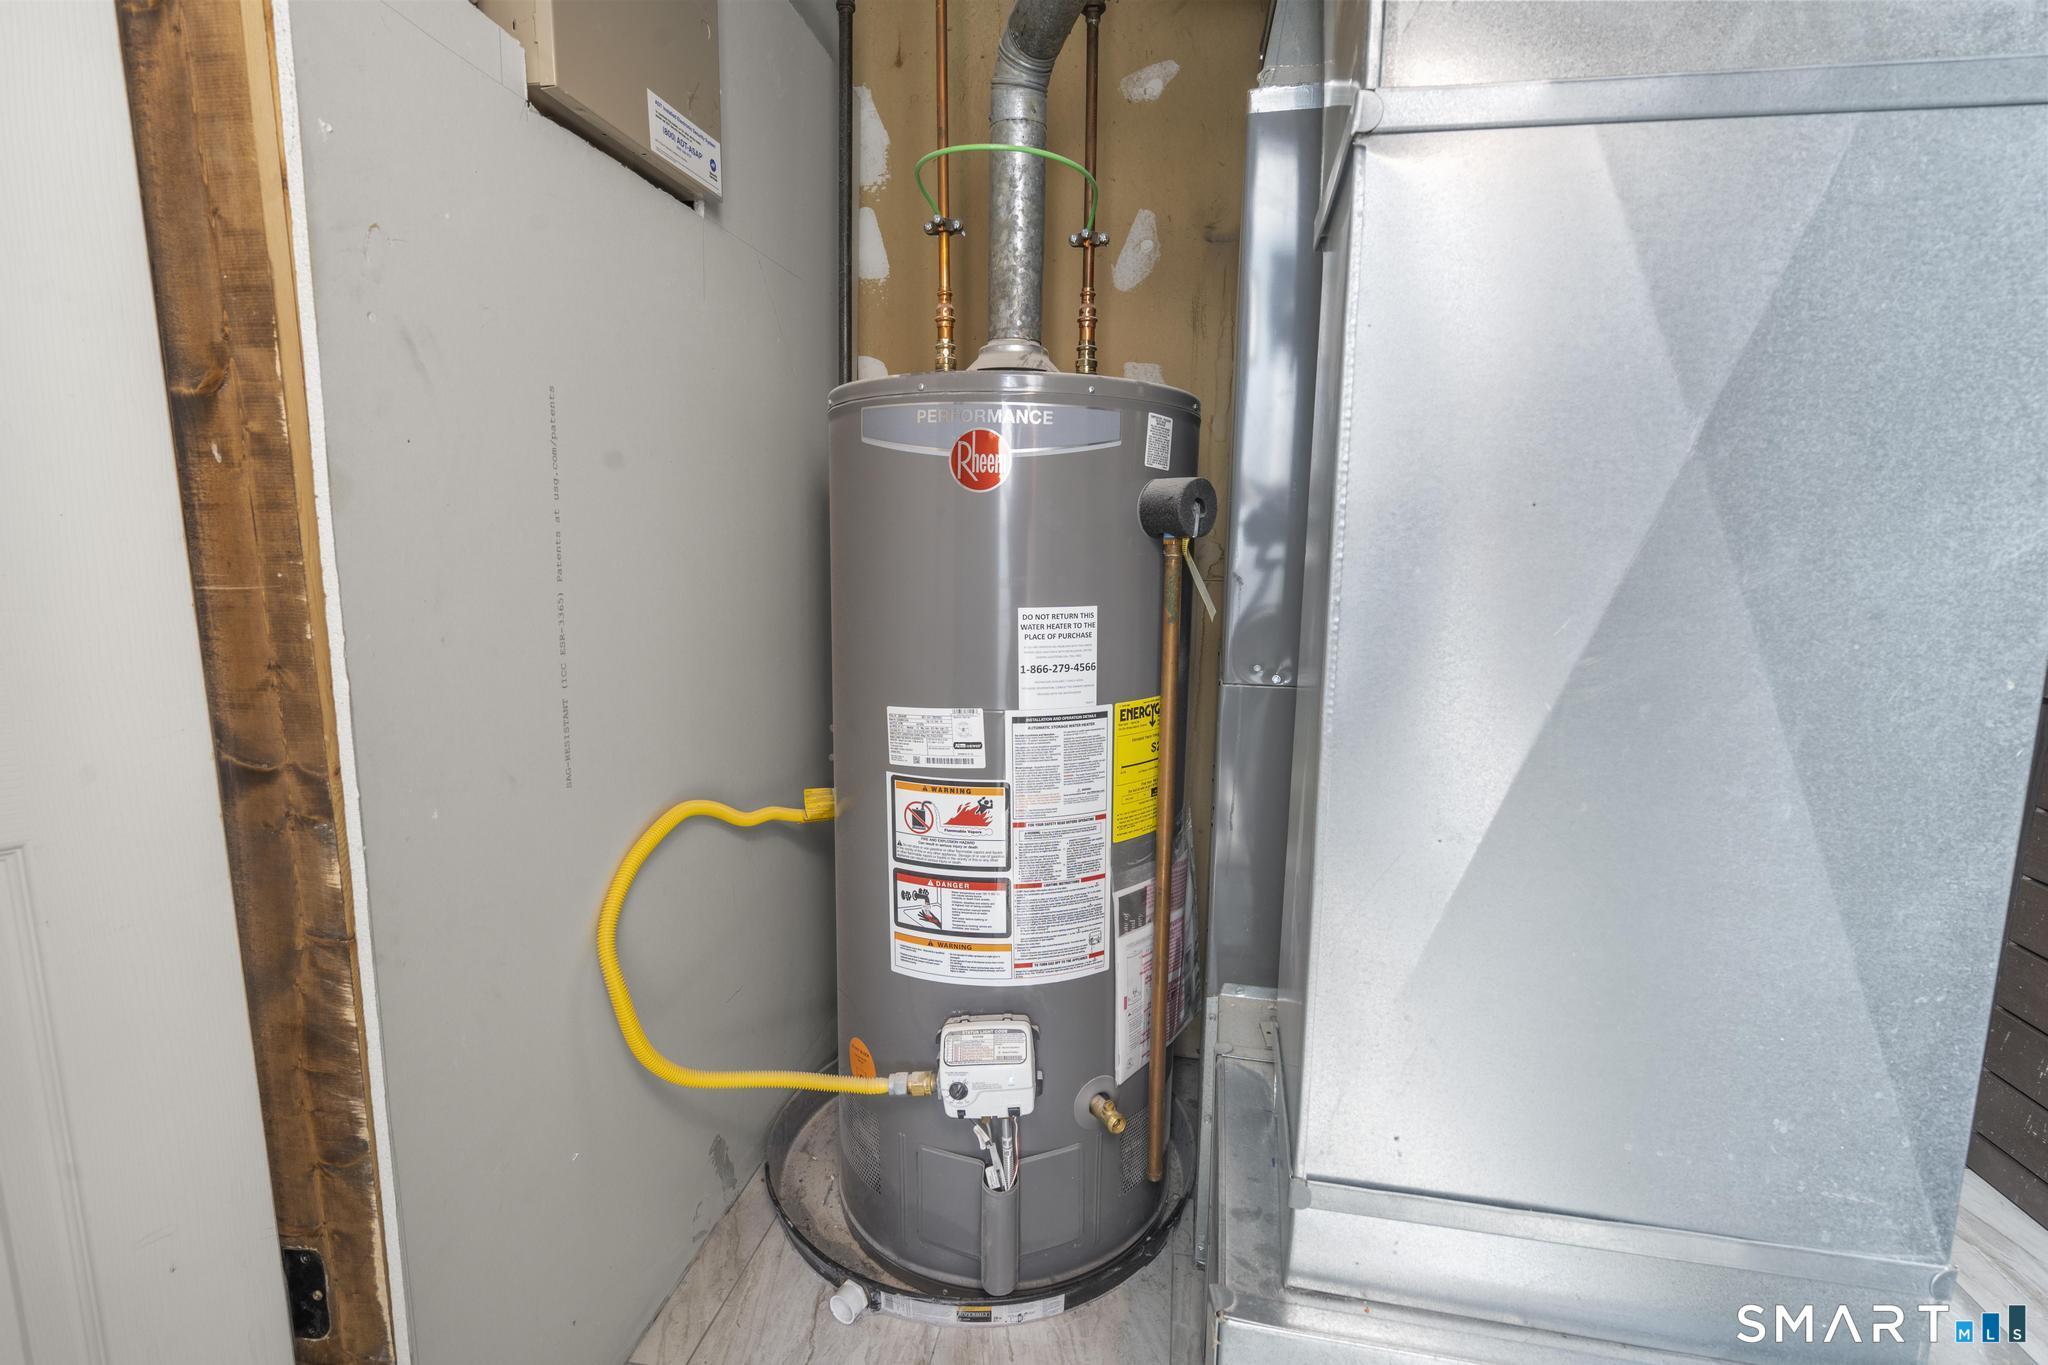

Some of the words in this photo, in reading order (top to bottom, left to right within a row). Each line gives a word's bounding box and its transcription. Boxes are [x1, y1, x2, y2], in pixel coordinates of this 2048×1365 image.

[676, 137, 703, 159] ADT-ASAP
[916, 408, 1054, 425] PERFORMANCE
[546, 385, 562, 501] usg.com/patents
[957, 428, 1008, 481] Rheem
[553, 530, 564, 582] Patents
[1022, 613, 1033, 621] DO
[1034, 613, 1050, 621] NOT
[1051, 612, 1079, 620] RETURN
[1080, 611, 1095, 619] THIS
[1020, 623, 1045, 631] WATER
[1046, 622, 1073, 630] HEATER
[1083, 621, 1096, 629] THE
[1024, 633, 1046, 641] PLACE
[1057, 631, 1093, 639] PURCHASE
[1020, 662, 1097, 674] 1-866-279-4566
[561, 699, 573, 789] SAG-RESISTANT
[930, 786, 972, 795] WARNING
[935, 880, 970, 889] DANGER
[937, 942, 973, 951] WARNING
